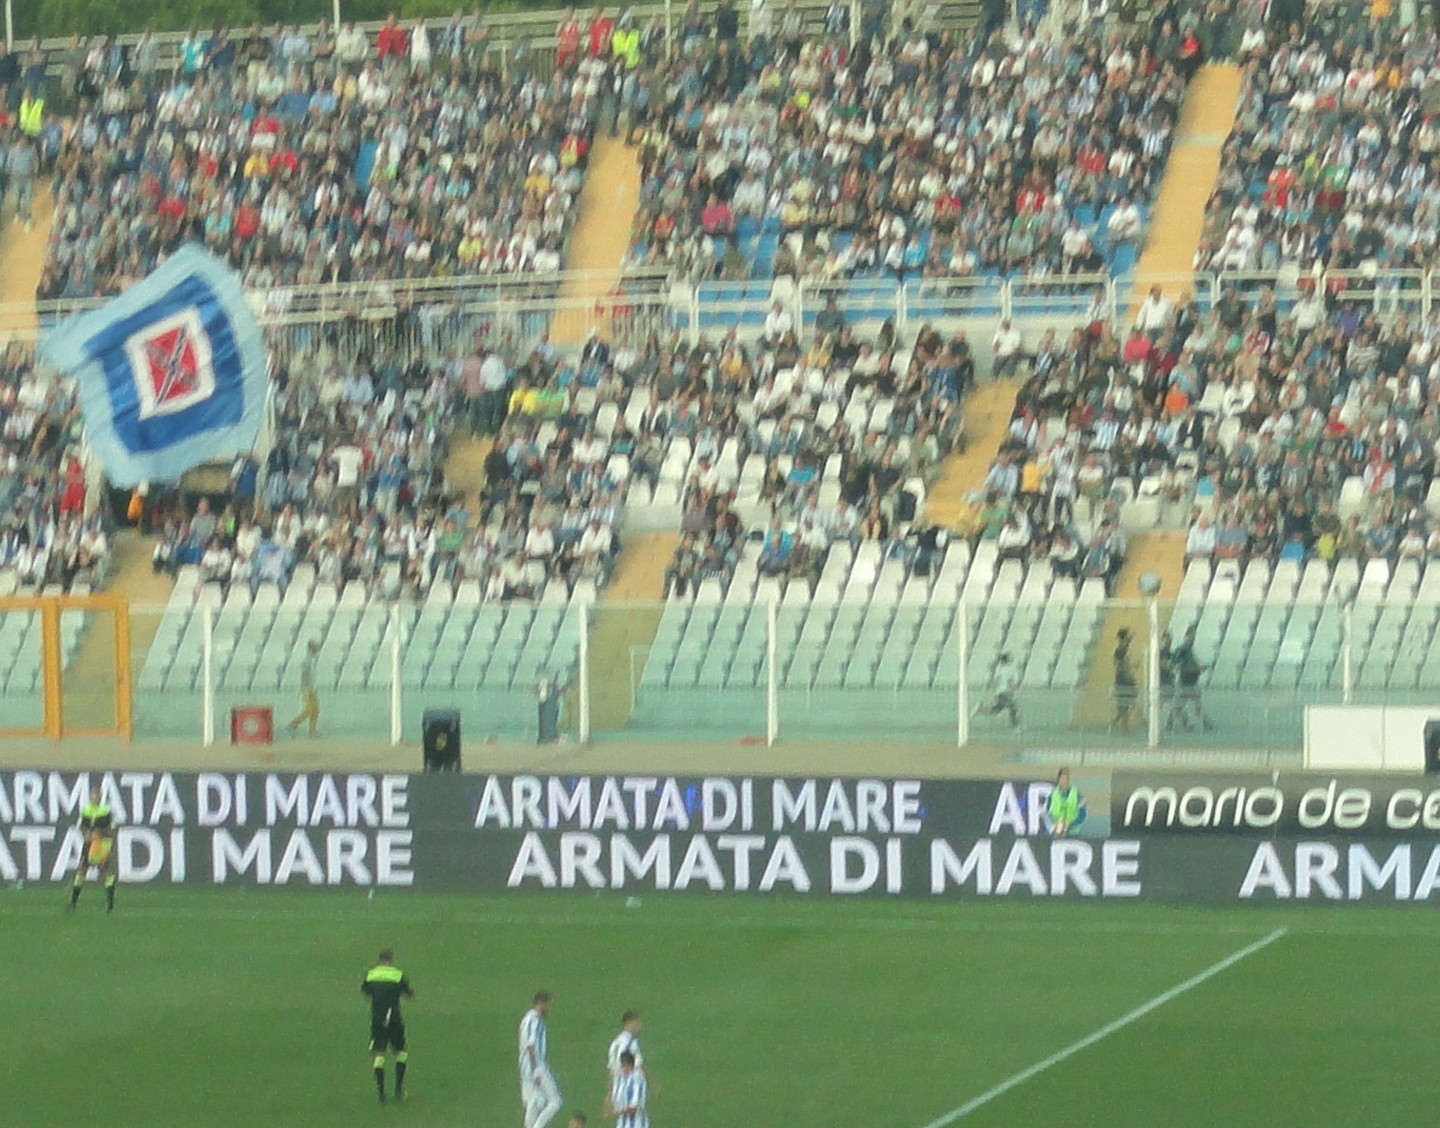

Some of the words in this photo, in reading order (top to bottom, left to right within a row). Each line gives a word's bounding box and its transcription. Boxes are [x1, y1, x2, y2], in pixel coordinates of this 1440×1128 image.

[196, 771, 248, 827] DI
[264, 772, 410, 828] MARE
[474, 774, 690, 831] ARMATA
[701, 776, 754, 832] DI
[771, 778, 922, 834] MARE
[1124, 786, 1284, 828] mario
[1298, 778, 1370, 829] de
[116, 825, 186, 883] DI
[211, 825, 415, 886] MARE
[507, 827, 814, 892] ARMATA
[829, 835, 903, 894] DI
[930, 835, 1142, 897] MARE
